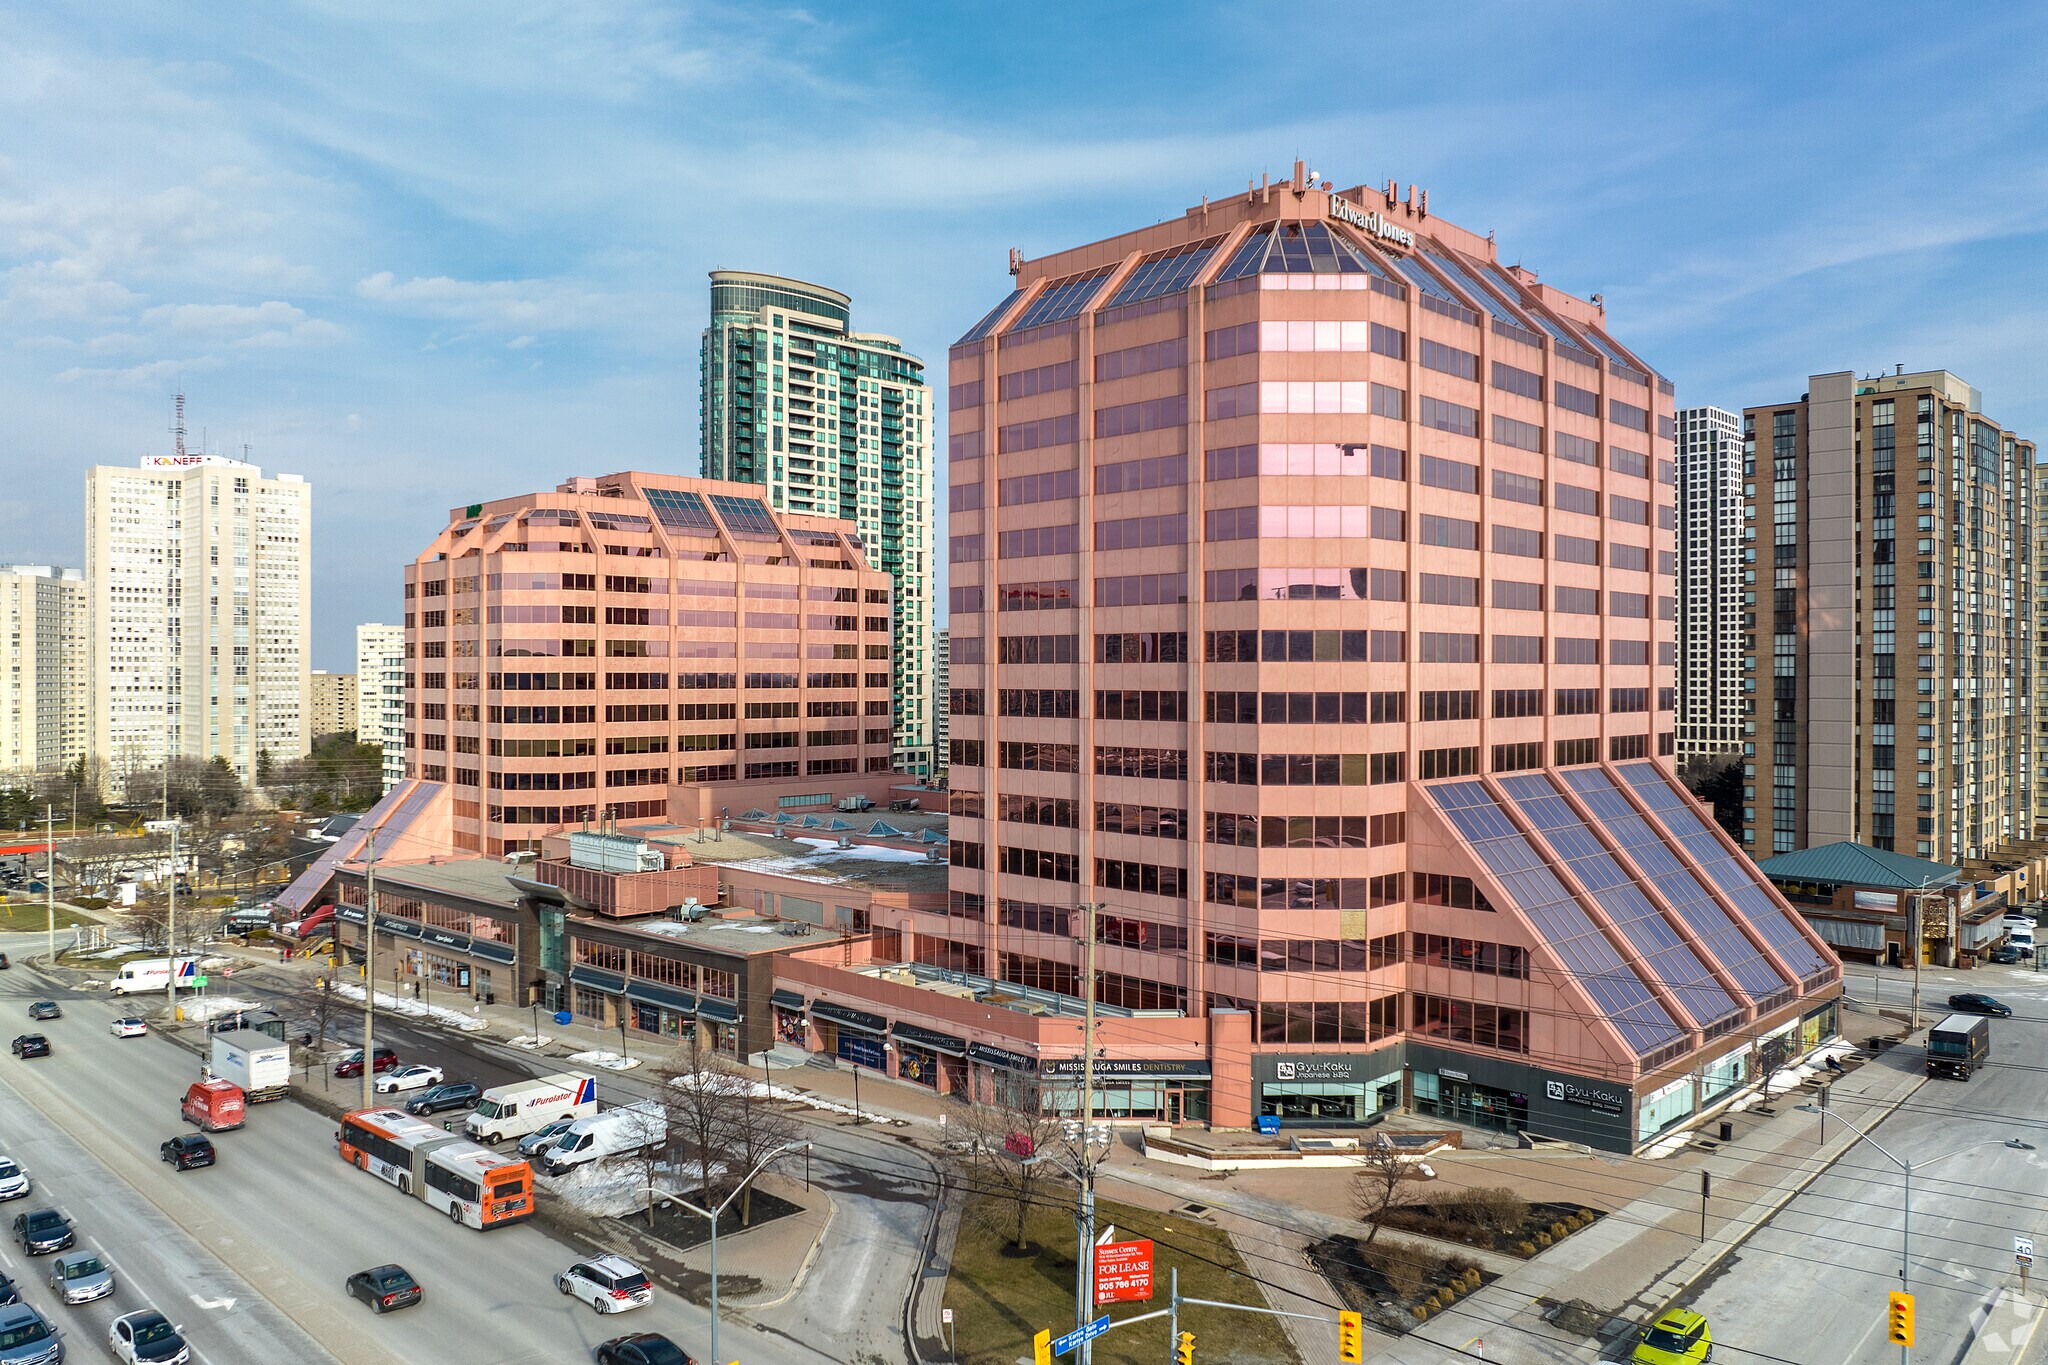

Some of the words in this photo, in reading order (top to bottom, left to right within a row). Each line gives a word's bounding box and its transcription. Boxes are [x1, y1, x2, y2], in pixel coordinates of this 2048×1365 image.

[1331, 194, 1377, 232] Edward
[1378, 213, 1414, 247] Jones
[153, 457, 202, 466] KANEFF
[978, 1046, 1009, 1059] MISSISSAUGA
[1009, 1053, 1027, 1064] SMILES
[1059, 1063, 1112, 1072] MISSISAUGA
[1113, 1063, 1142, 1072] SMILES
[1143, 1063, 1186, 1072] DENTISTRY
[1296, 1062, 1352, 1072] Gyu-Kaku
[1296, 1071, 1330, 1079] Japanese
[534, 1092, 572, 1107] Purolator
[1565, 1084, 1623, 1104] Gyu-Kaku
[2016, 1245, 2032, 1256] 40
[1099, 1264, 1118, 1275] FOR
[1119, 1261, 1150, 1273] LEASE
[1098, 1282, 1114, 1291] 905
[1131, 1278, 1148, 1287] 4170
